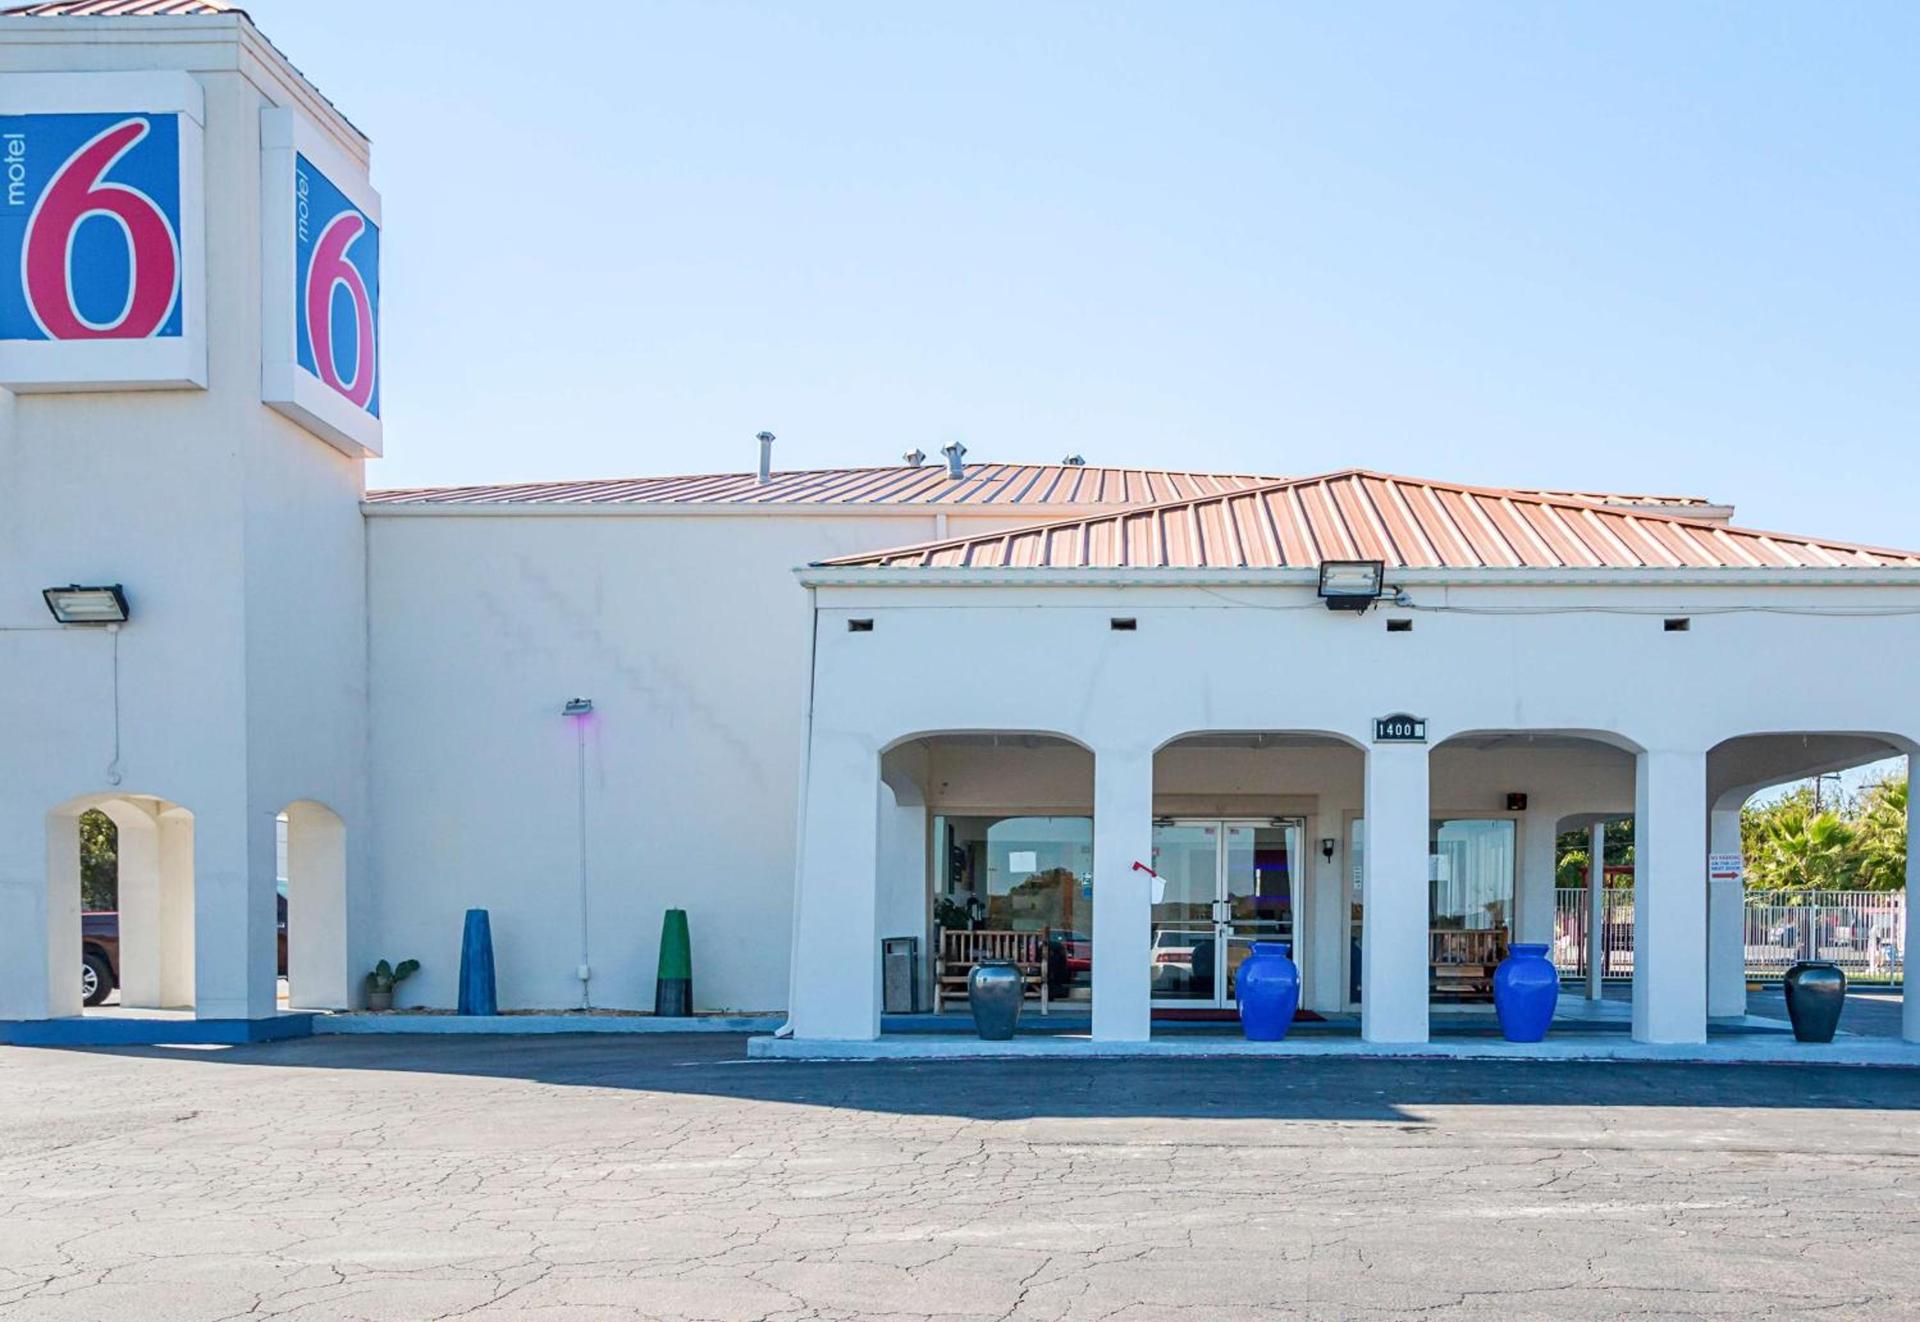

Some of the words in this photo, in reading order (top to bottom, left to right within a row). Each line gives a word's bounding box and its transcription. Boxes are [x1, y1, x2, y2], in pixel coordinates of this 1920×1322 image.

[4, 133, 25, 205] motel
[21, 117, 181, 341] 6
[296, 168, 310, 243] motel
[305, 210, 376, 410] 6
[1379, 723, 1411, 736] 1400
